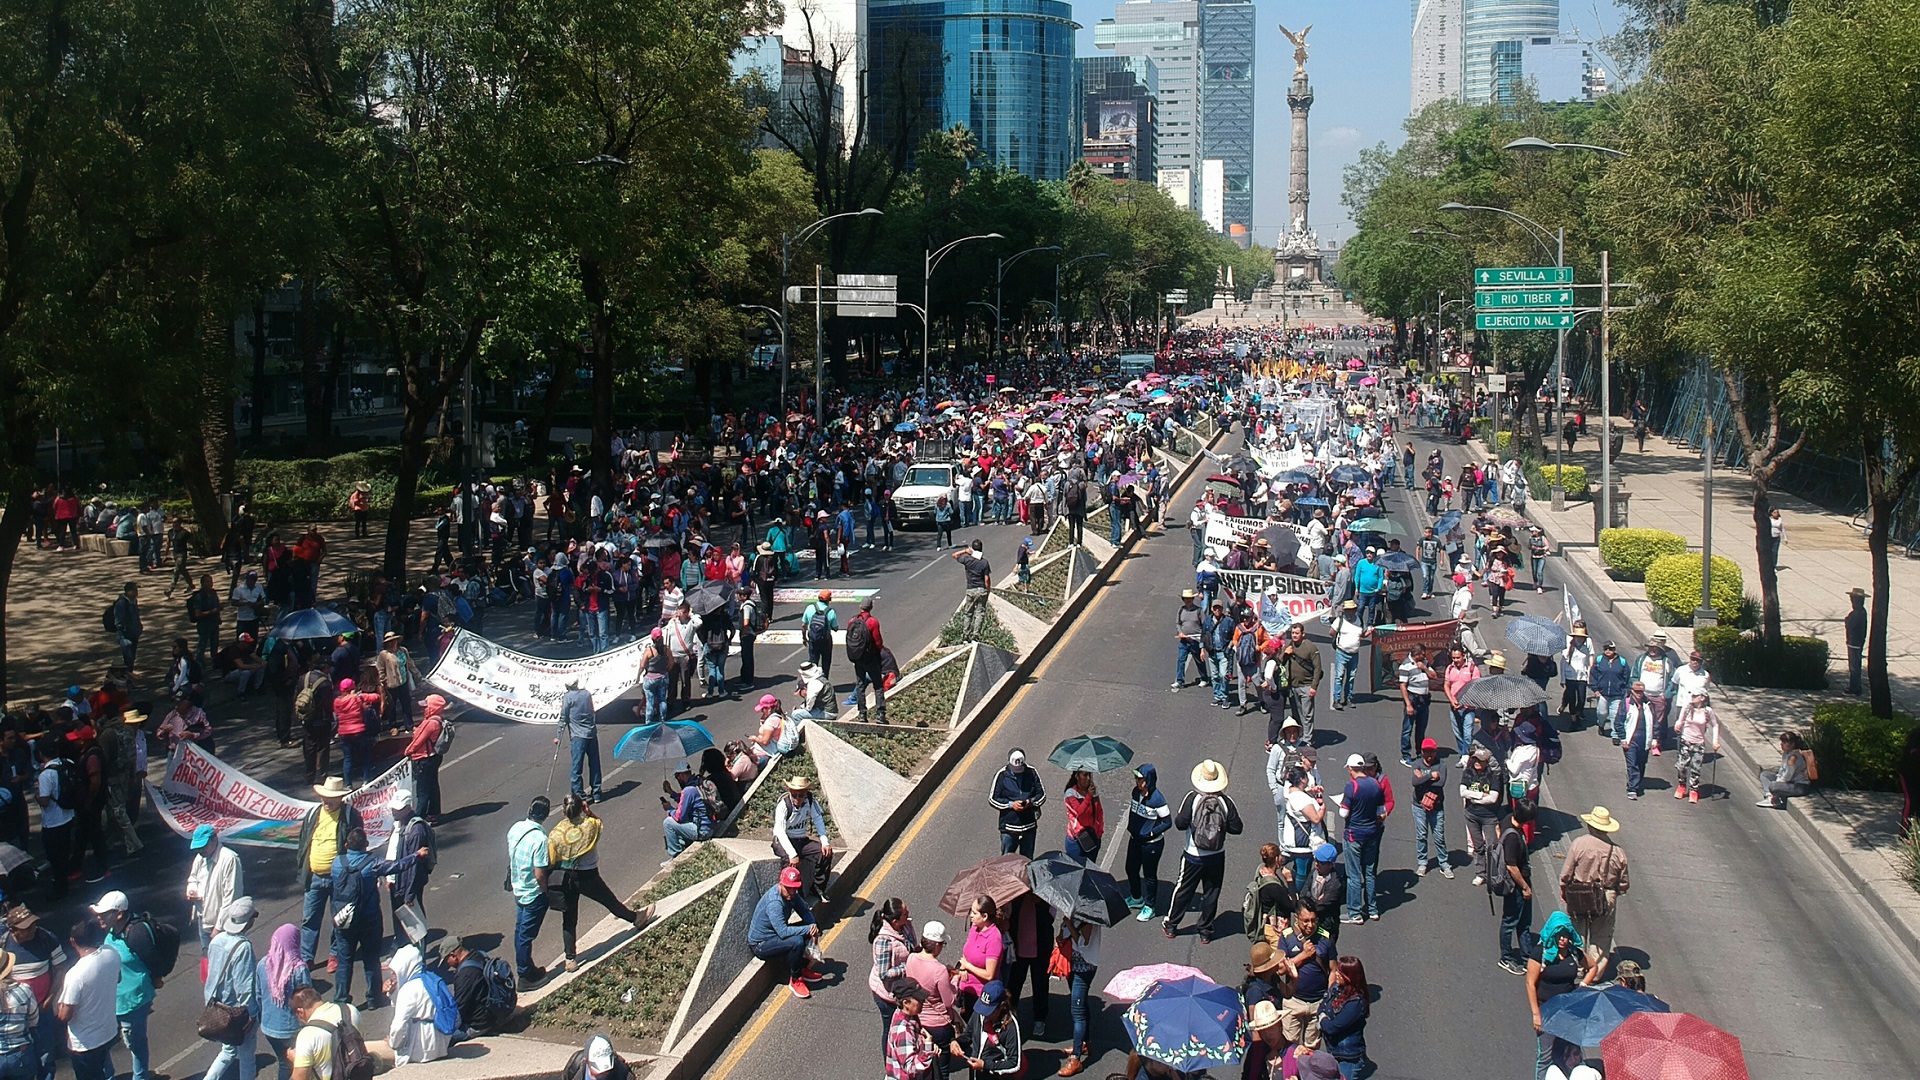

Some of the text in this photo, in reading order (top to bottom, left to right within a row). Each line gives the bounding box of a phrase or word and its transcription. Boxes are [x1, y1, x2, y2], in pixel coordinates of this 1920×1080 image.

[1499, 271, 1565, 281] SEVILLA 3
[1484, 293, 1552, 304] 2 RIO TIBER
[1484, 316, 1554, 327] EJERCITO NAL
[1224, 516, 1264, 529] EXIGIMOS
[1219, 571, 1326, 596] UNIVERSIDAD
[1379, 630, 1450, 645] Universidades
[1387, 639, 1452, 652] Altertiva
[494, 646, 548, 667] TUXPAN
[495, 705, 560, 720] SECCION
[172, 763, 199, 787] ARIO
